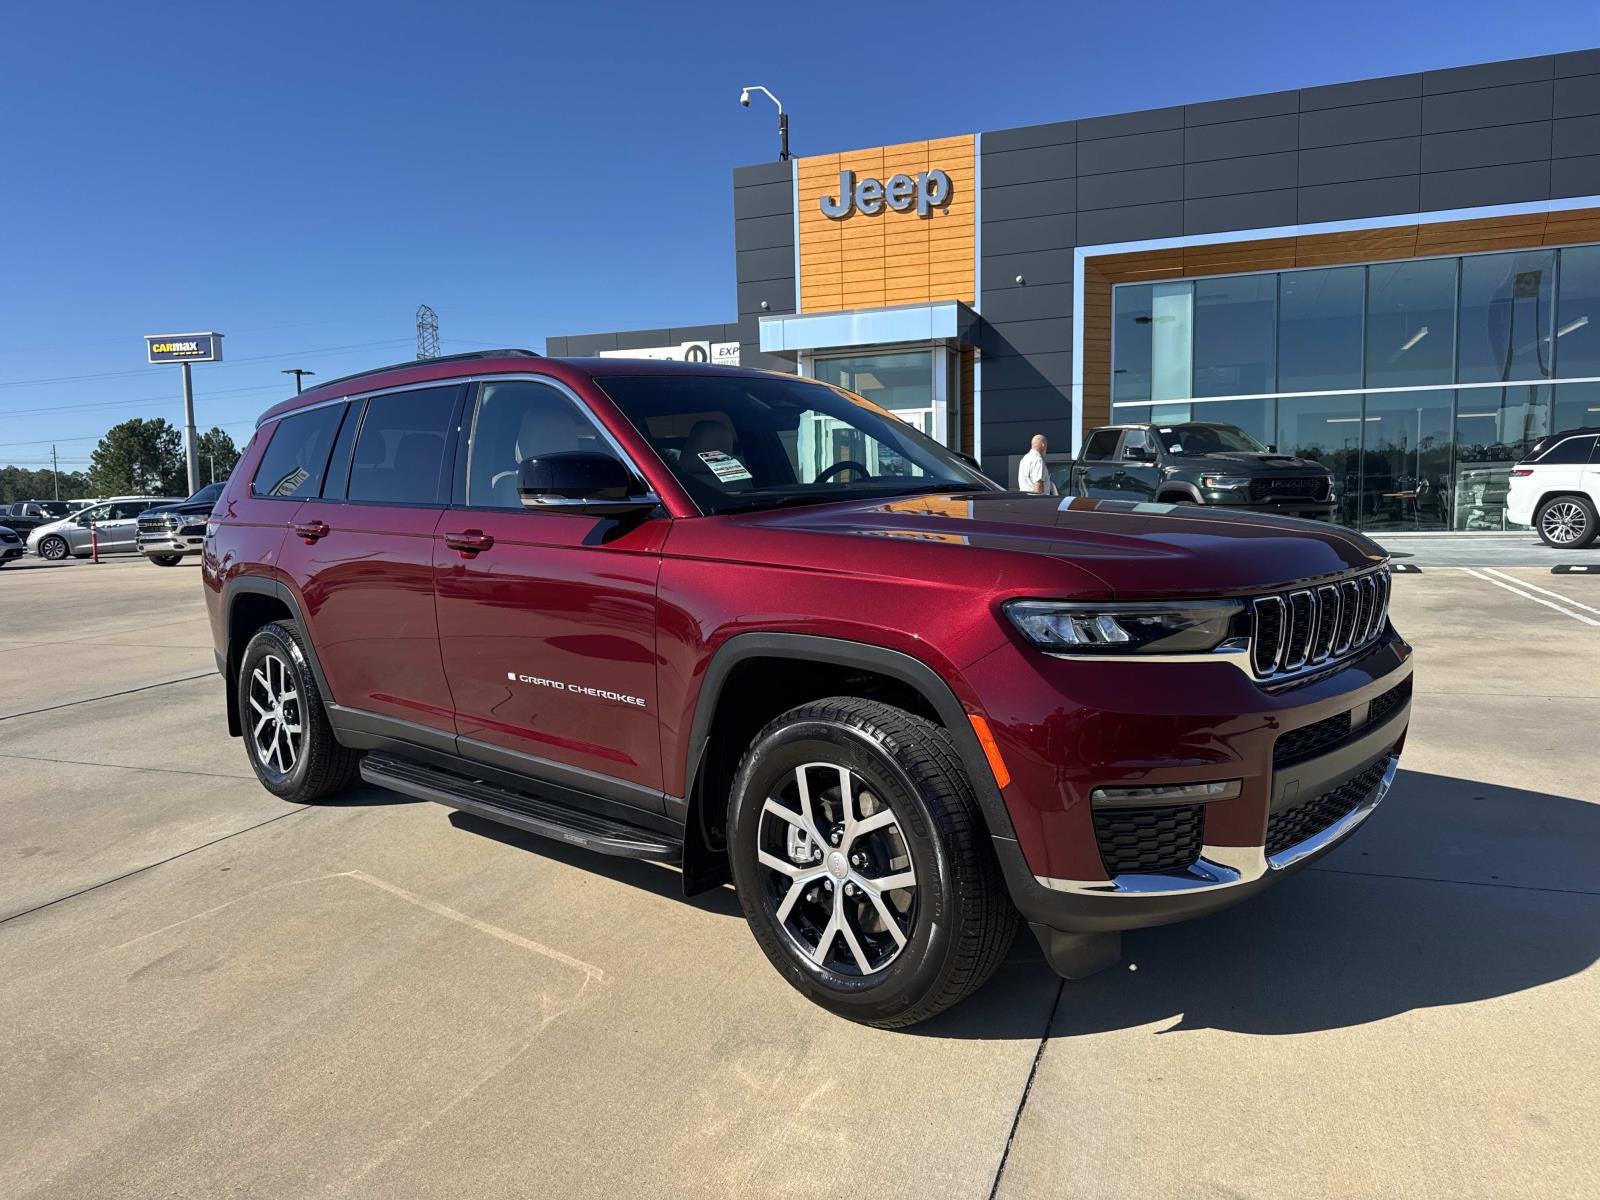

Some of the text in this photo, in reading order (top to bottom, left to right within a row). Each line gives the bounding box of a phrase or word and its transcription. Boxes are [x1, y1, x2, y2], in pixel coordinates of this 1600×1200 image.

[819, 169, 949, 218] Jeep
[519, 674, 646, 707] GRAND CHEROKEE
